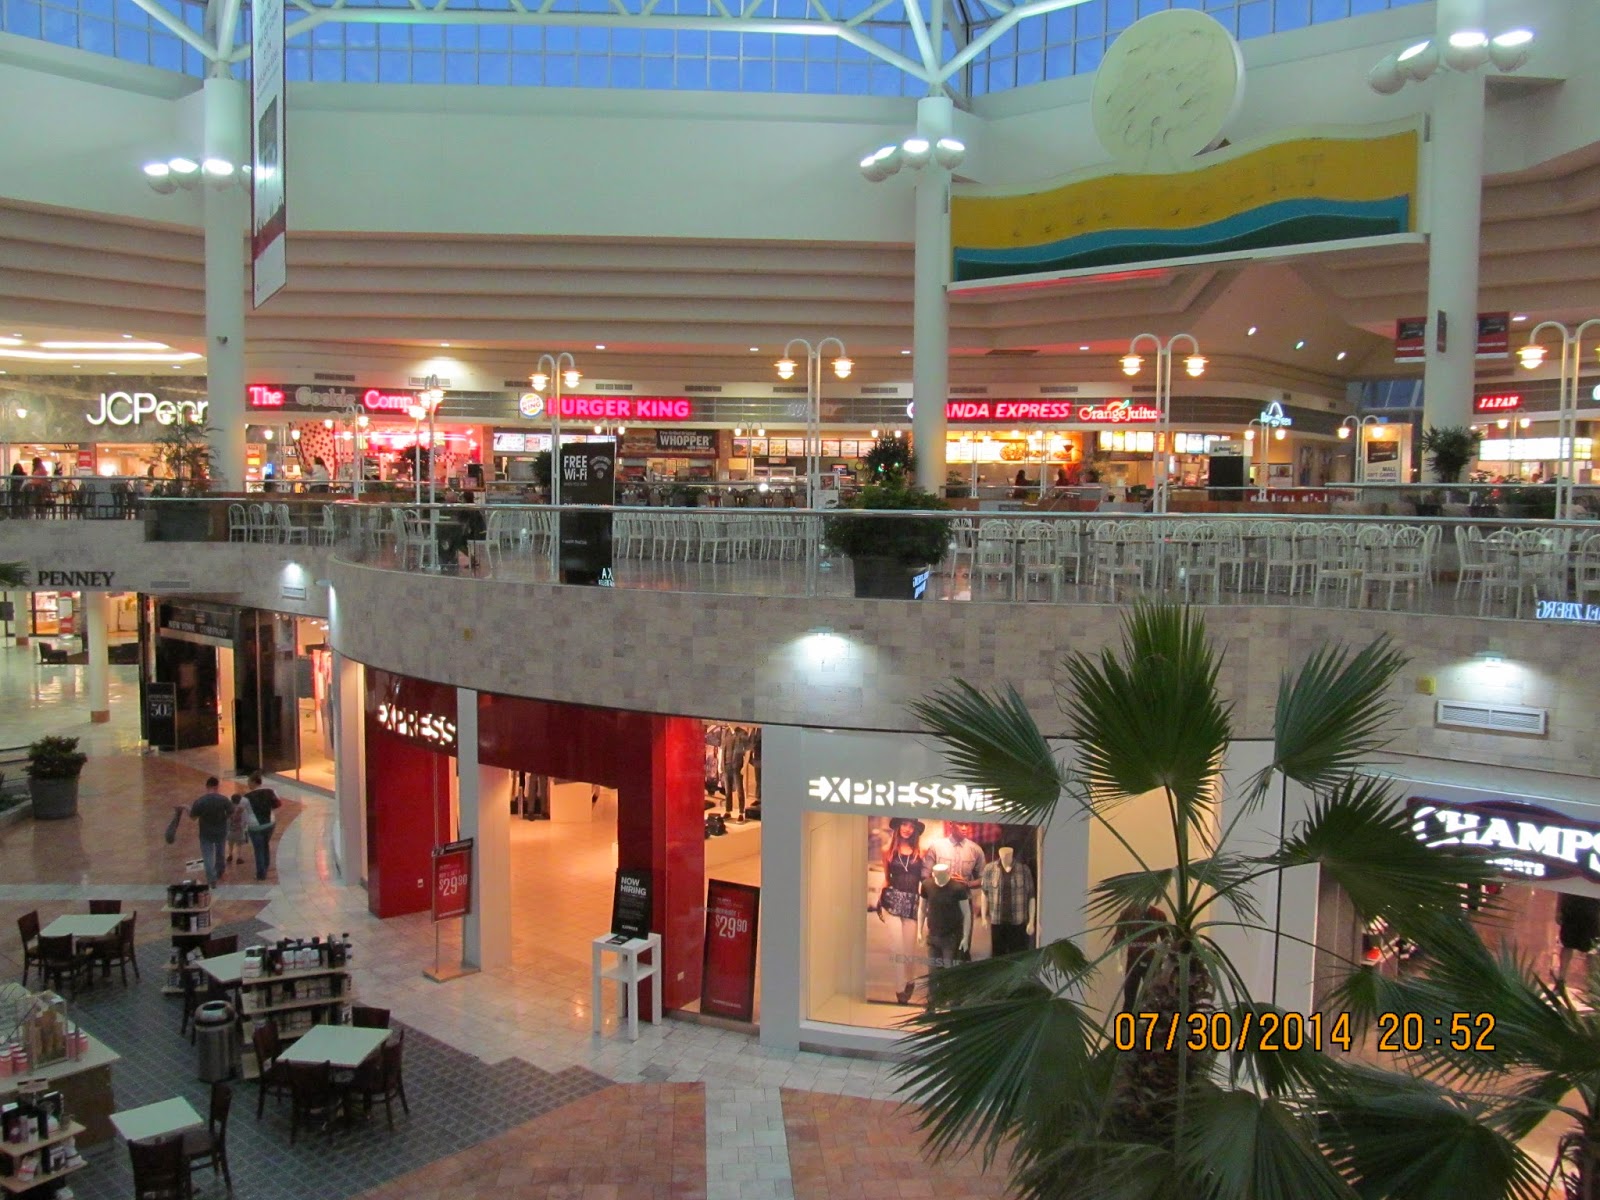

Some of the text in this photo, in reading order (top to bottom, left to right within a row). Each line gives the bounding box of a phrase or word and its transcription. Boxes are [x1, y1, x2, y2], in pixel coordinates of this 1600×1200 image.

[250, 386, 415, 413] The Cookie Comp
[1479, 396, 1519, 408] JAPAN
[637, 400, 689, 417] KING
[946, 403, 1072, 418] NDA EXPRESS
[1079, 405, 1126, 422] Orange
[660, 436, 710, 446] WHOPPER
[563, 455, 588, 468] FREE
[564, 468, 588, 481] Wi-Fi
[38, 570, 116, 587] PENNEY
[377, 702, 457, 746] EXPRESS
[621, 876, 640, 887] NOW
[620, 885, 647, 896] HIRING
